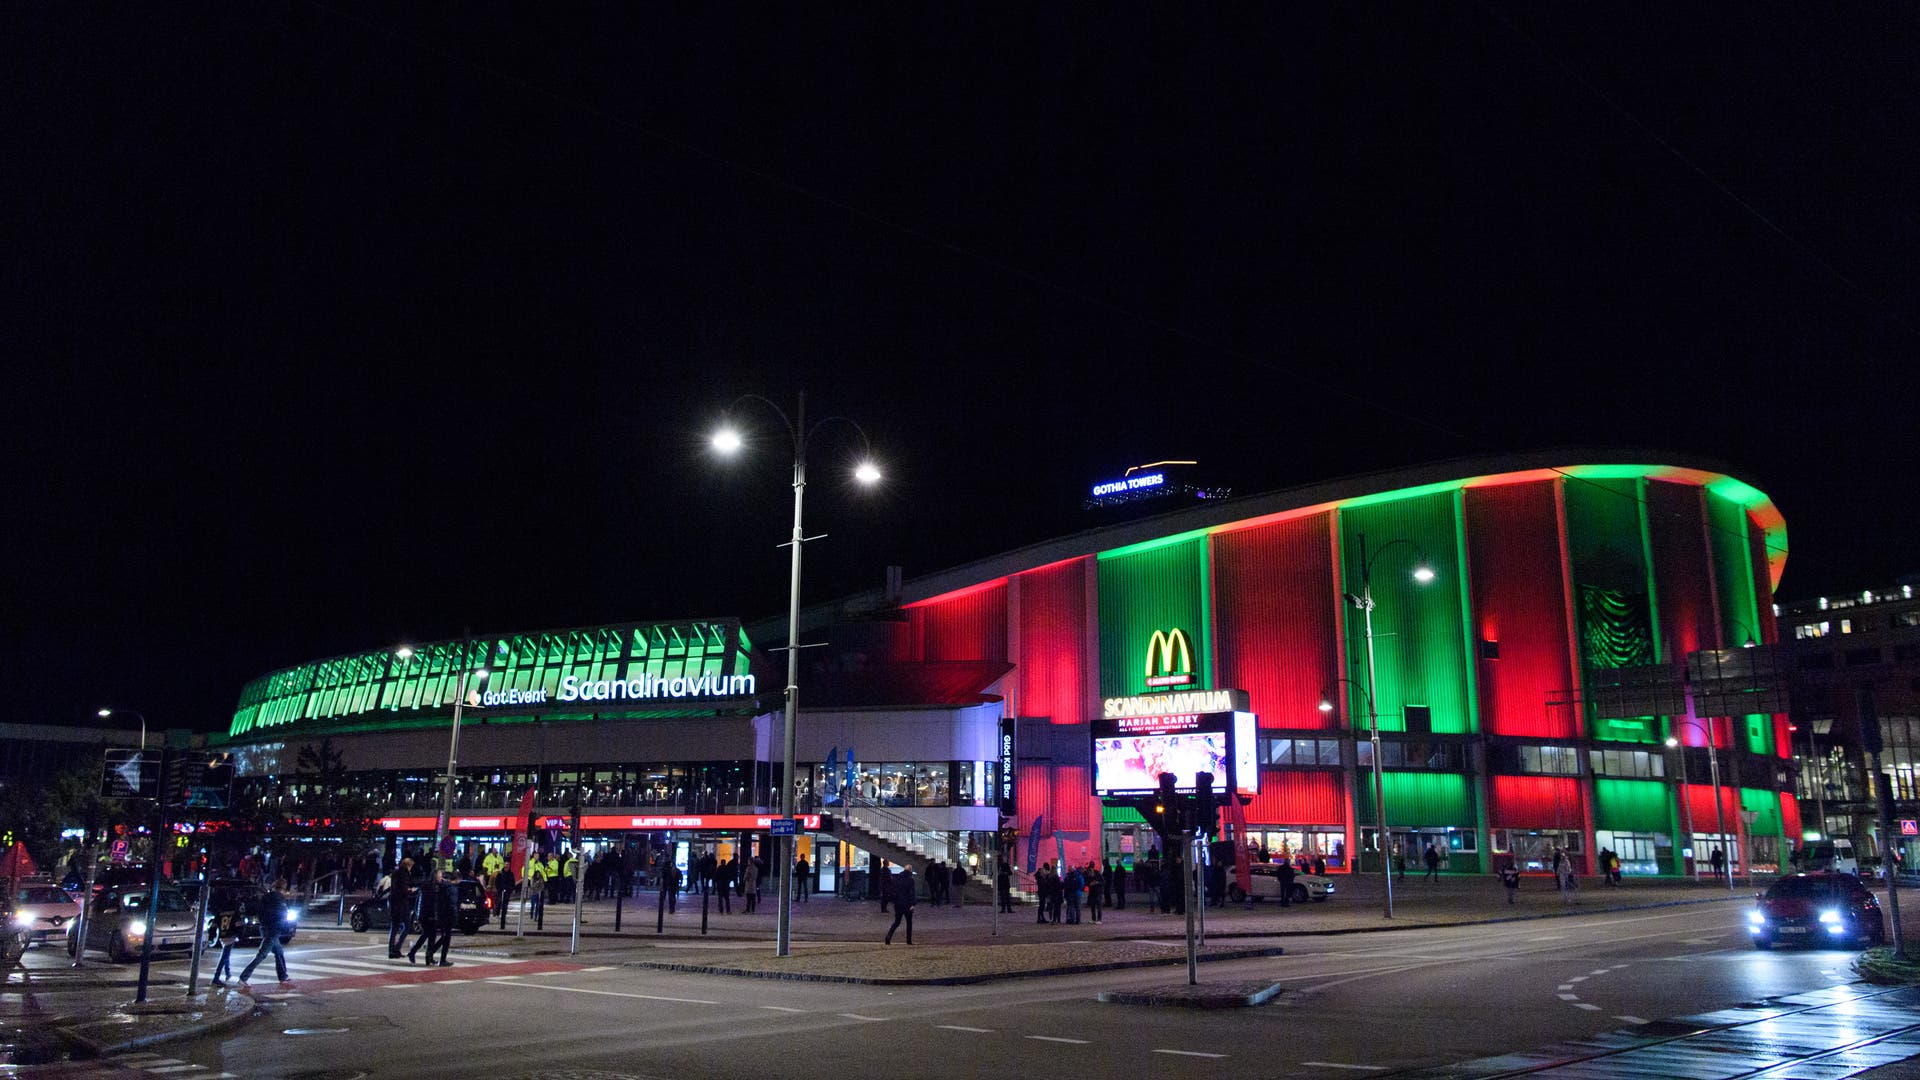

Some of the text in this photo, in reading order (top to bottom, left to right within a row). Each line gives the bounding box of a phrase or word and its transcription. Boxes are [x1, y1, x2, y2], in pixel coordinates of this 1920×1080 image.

[1094, 474, 1163, 495] GOTHIA TOWERS
[561, 670, 755, 701] Scandinavium
[483, 687, 547, 706] Got Event
[1104, 690, 1231, 717] SCANDINAVIUM
[1119, 715, 1198, 727] MARIAH CAREY
[1003, 735, 1011, 756] Glöd
[1003, 757, 1011, 774] Kök
[1003, 784, 1011, 799] Bar
[546, 819, 558, 827] VIP
[632, 818, 668, 826] BILJETTER
[673, 818, 702, 826] TICKETS
